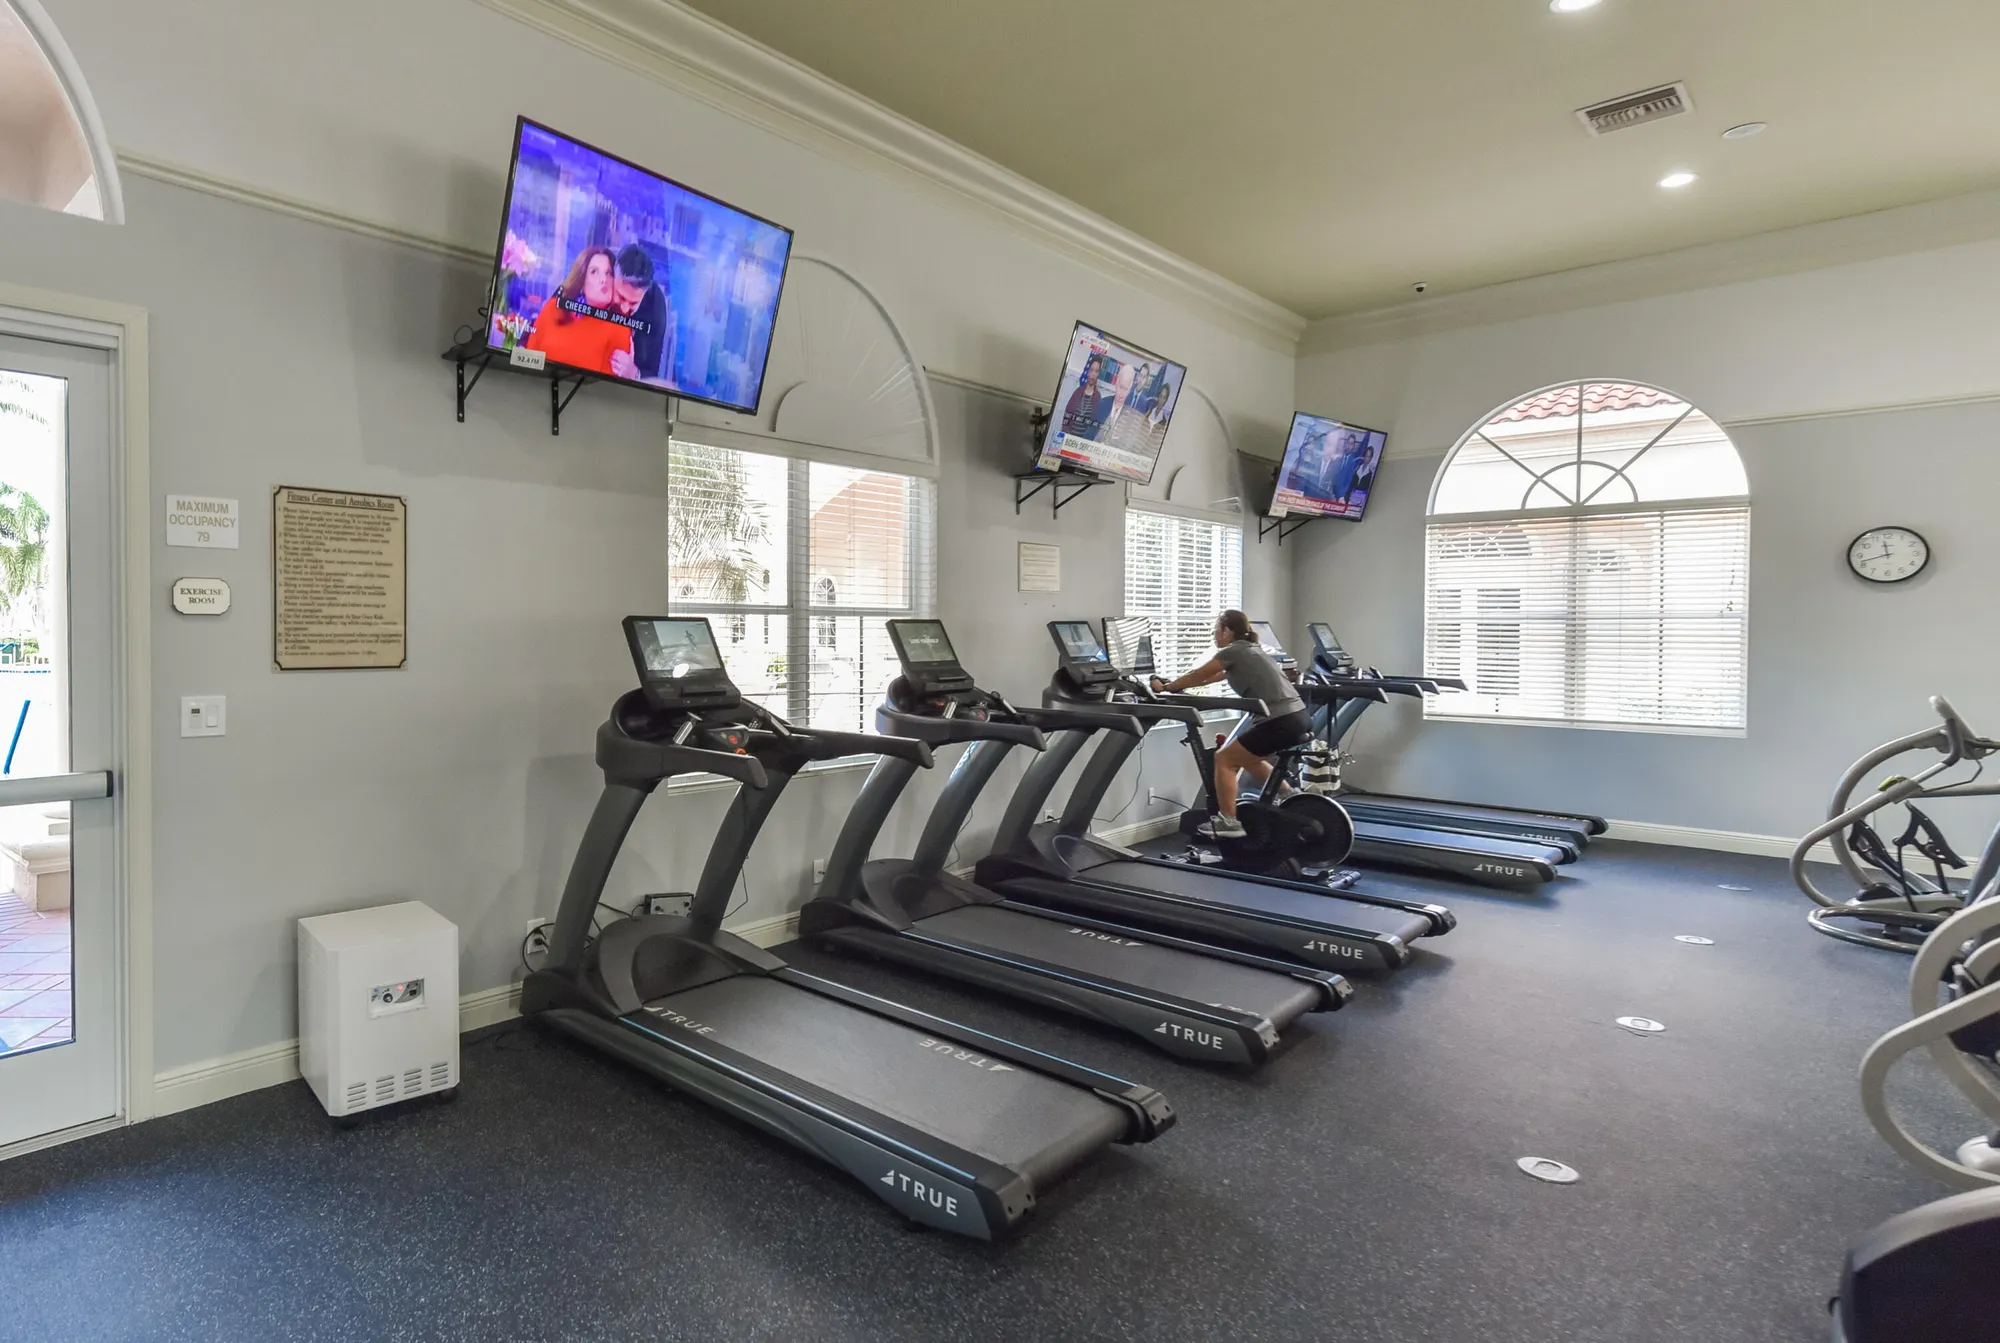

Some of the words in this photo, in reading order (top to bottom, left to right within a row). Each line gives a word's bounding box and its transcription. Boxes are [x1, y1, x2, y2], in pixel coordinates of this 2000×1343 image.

[564, 299, 592, 315] CHEERS
[594, 308, 608, 320] AND
[611, 313, 644, 330] APPLAUSE
[176, 500, 229, 514] MAXIMUM
[287, 491, 310, 502] Fitness
[312, 493, 333, 505] Center
[335, 496, 347, 505] and
[349, 497, 376, 508] Aerobics
[377, 499, 395, 509] Room
[169, 513, 236, 528] OCCUPANCY
[197, 531, 210, 542] 79
[1908, 540, 1916, 548] 2
[1884, 569, 1891, 577] 6
[1485, 864, 1524, 877] TRUE
[1069, 928, 1122, 945] TRUE
[1317, 941, 1363, 960] TRUE
[660, 1009, 715, 1035] TRUE
[1170, 1023, 1223, 1050] TRUE
[919, 1038, 988, 1068] TRUE
[898, 1173, 957, 1217] TRUE
